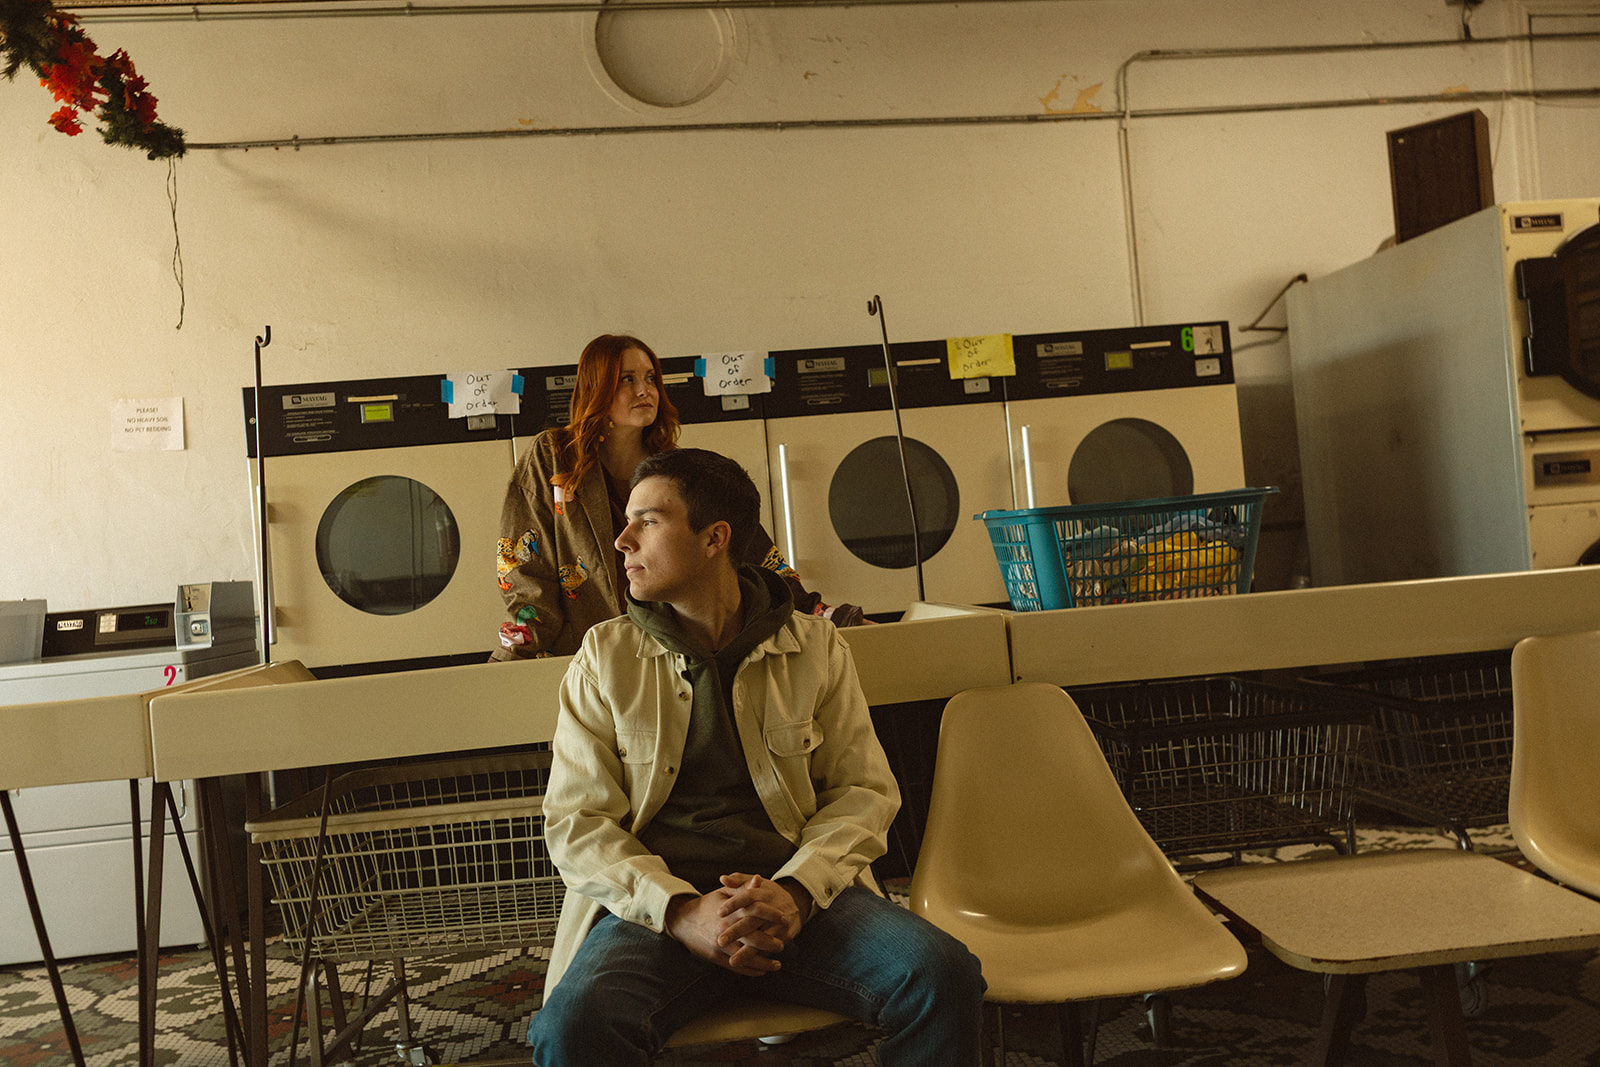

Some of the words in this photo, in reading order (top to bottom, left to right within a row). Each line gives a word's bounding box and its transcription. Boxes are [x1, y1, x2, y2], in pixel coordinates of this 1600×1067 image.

[1181, 326, 1194, 352] 6
[727, 364, 740, 375] of
[473, 383, 488, 396] of
[163, 665, 177, 687] 2
